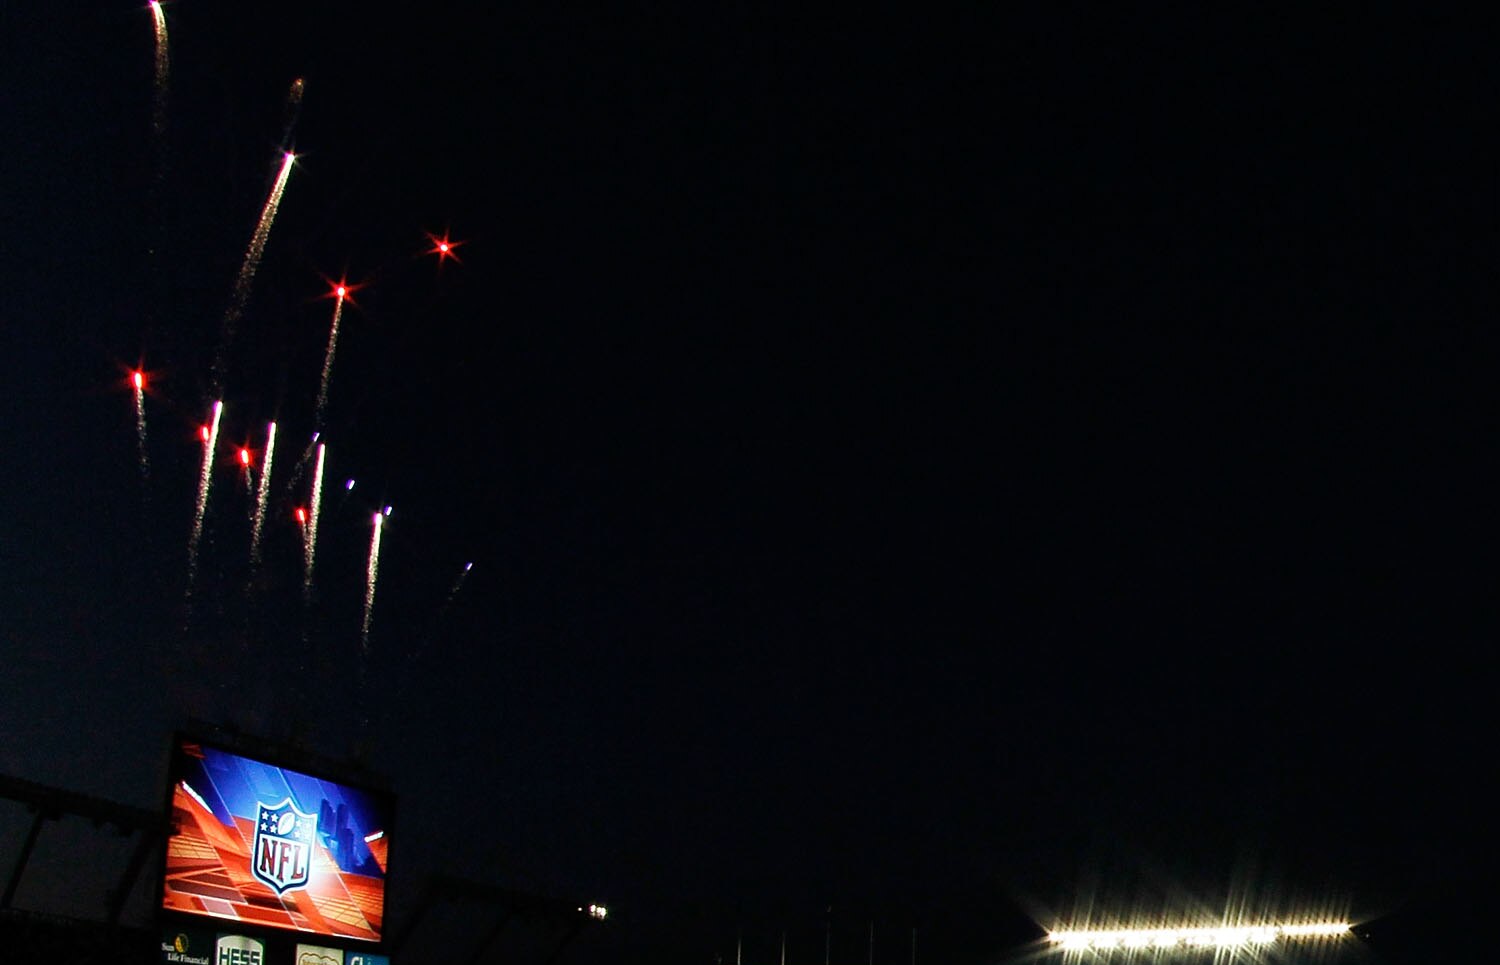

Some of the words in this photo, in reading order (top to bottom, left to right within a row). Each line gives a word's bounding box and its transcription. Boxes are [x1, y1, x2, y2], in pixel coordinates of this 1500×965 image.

[259, 838, 304, 883] NFL
[161, 942, 175, 952] Sun
[168, 953, 180, 963] Life
[180, 954, 209, 965] Financial
